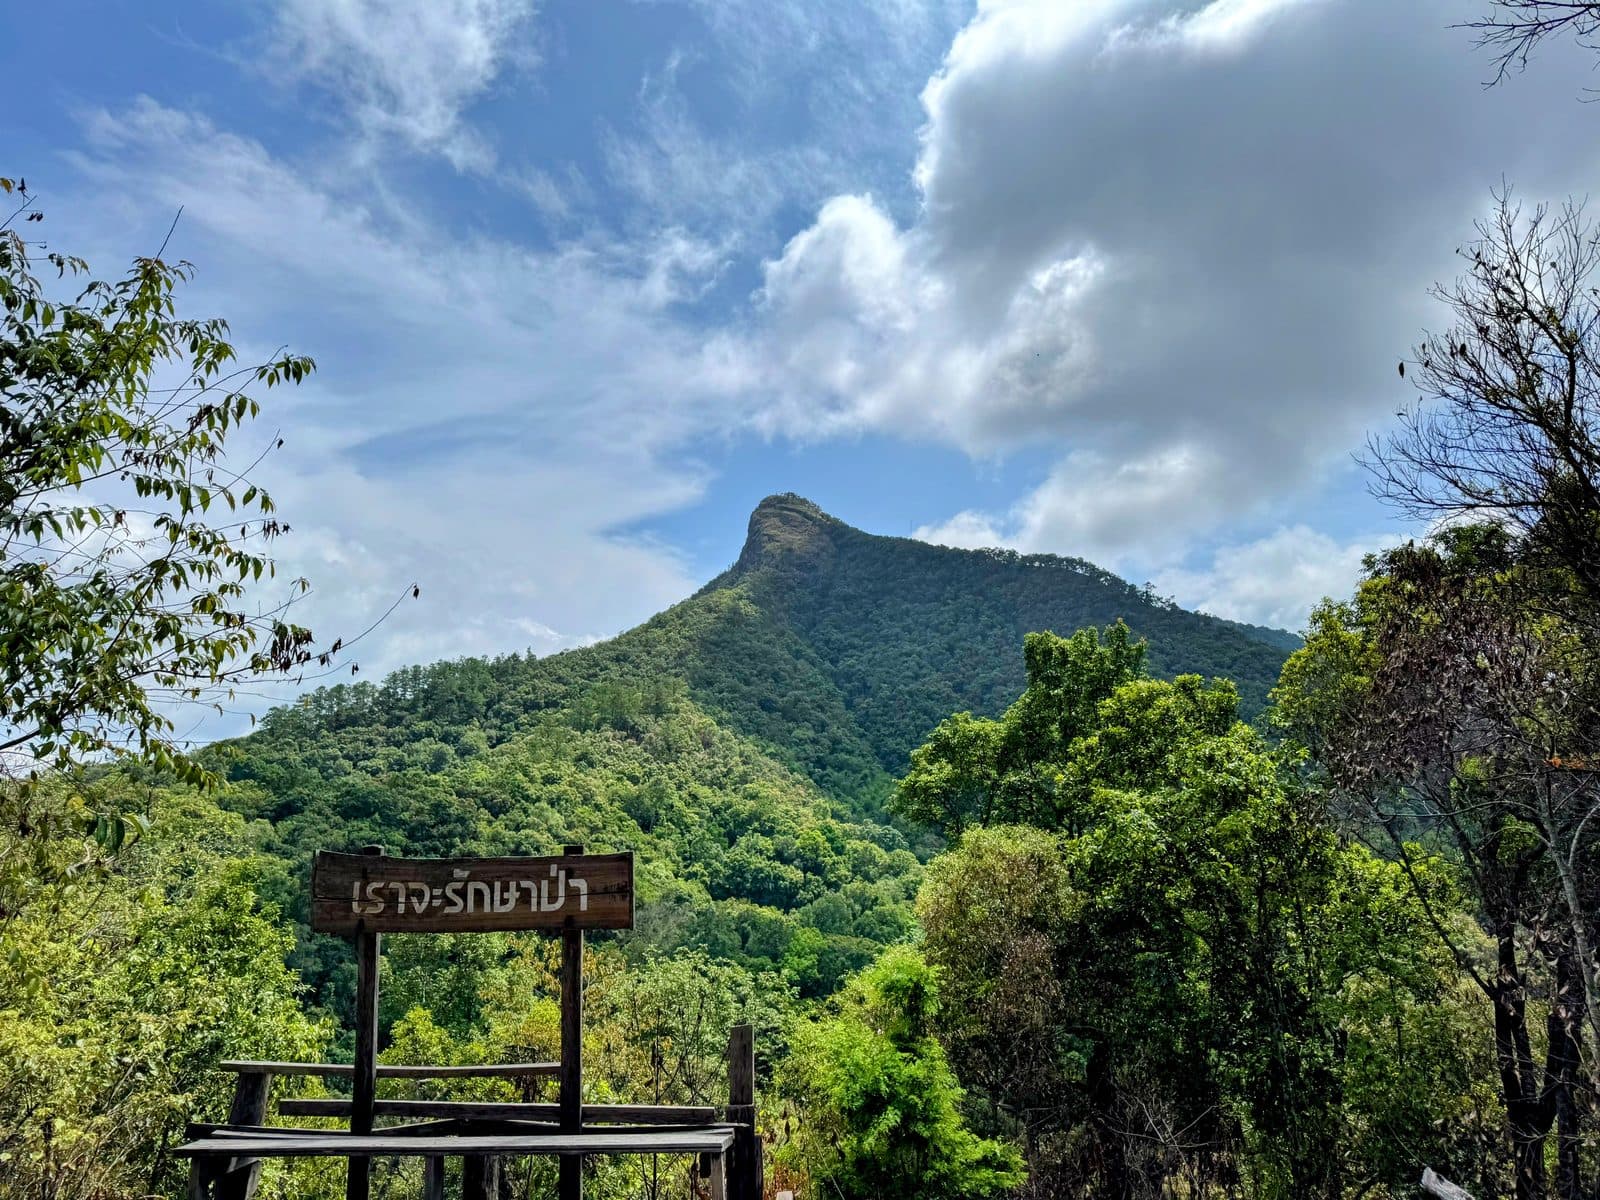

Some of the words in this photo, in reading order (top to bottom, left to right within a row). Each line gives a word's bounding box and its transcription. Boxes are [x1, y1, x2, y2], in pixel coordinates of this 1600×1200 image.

[352, 864, 588, 914] เราจะรักษาป่า
